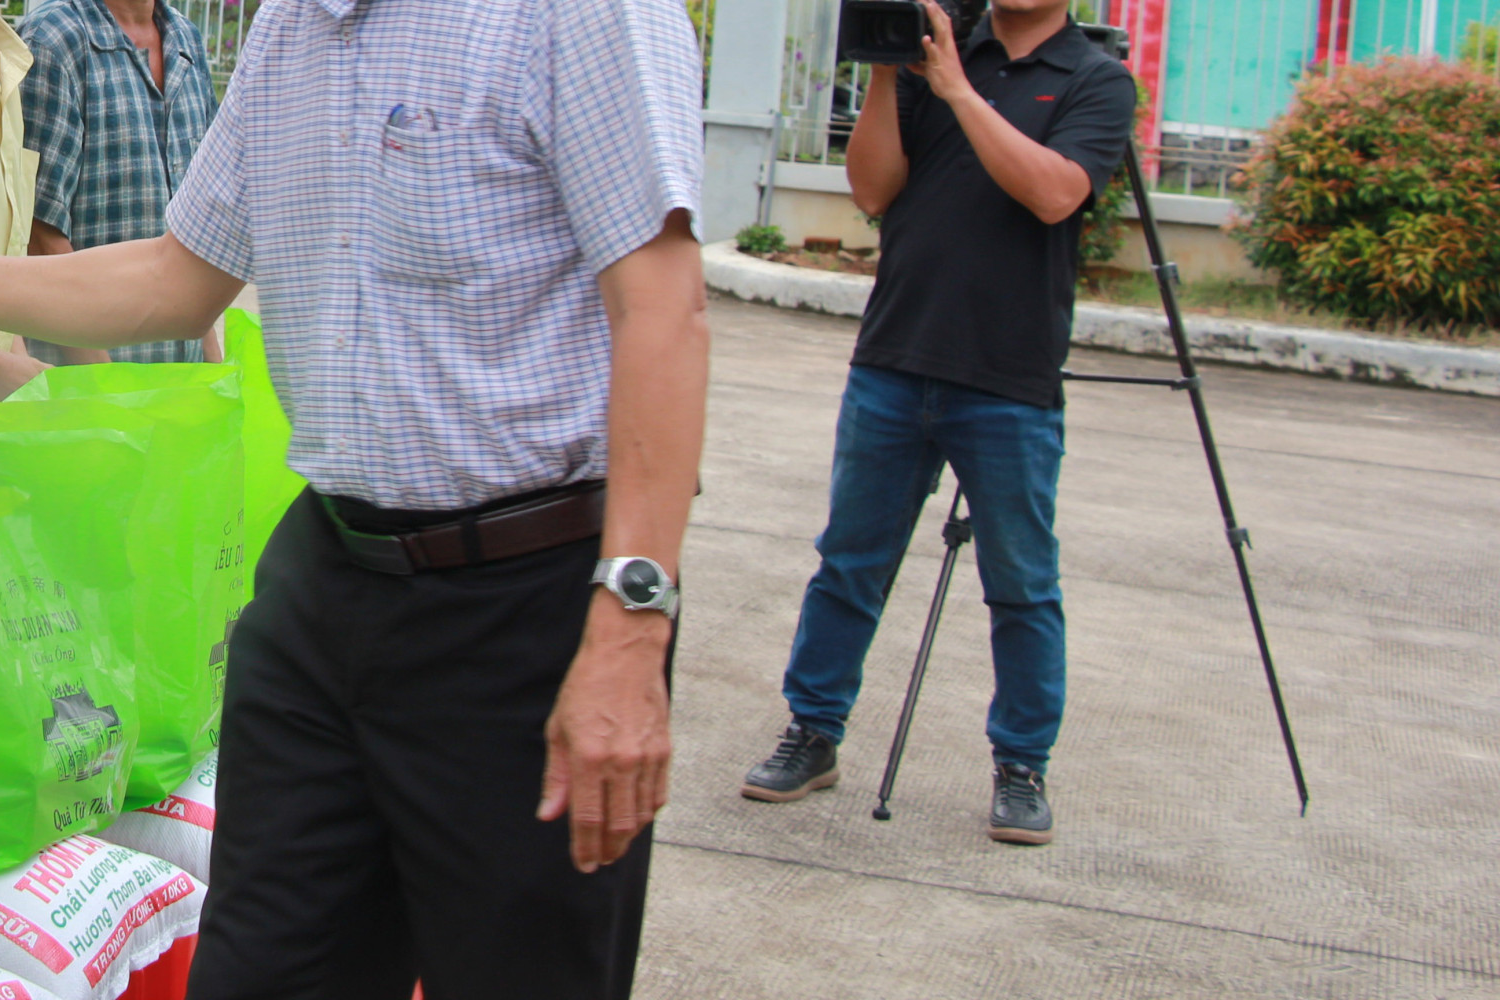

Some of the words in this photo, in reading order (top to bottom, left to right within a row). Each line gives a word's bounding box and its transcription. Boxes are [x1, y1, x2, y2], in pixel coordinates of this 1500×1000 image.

[51, 888, 88, 929] Chất
[79, 856, 119, 895] Lượng
[68, 906, 113, 957] Hương
[107, 879, 137, 911] Thơm
[162, 877, 189, 902] 10KG
